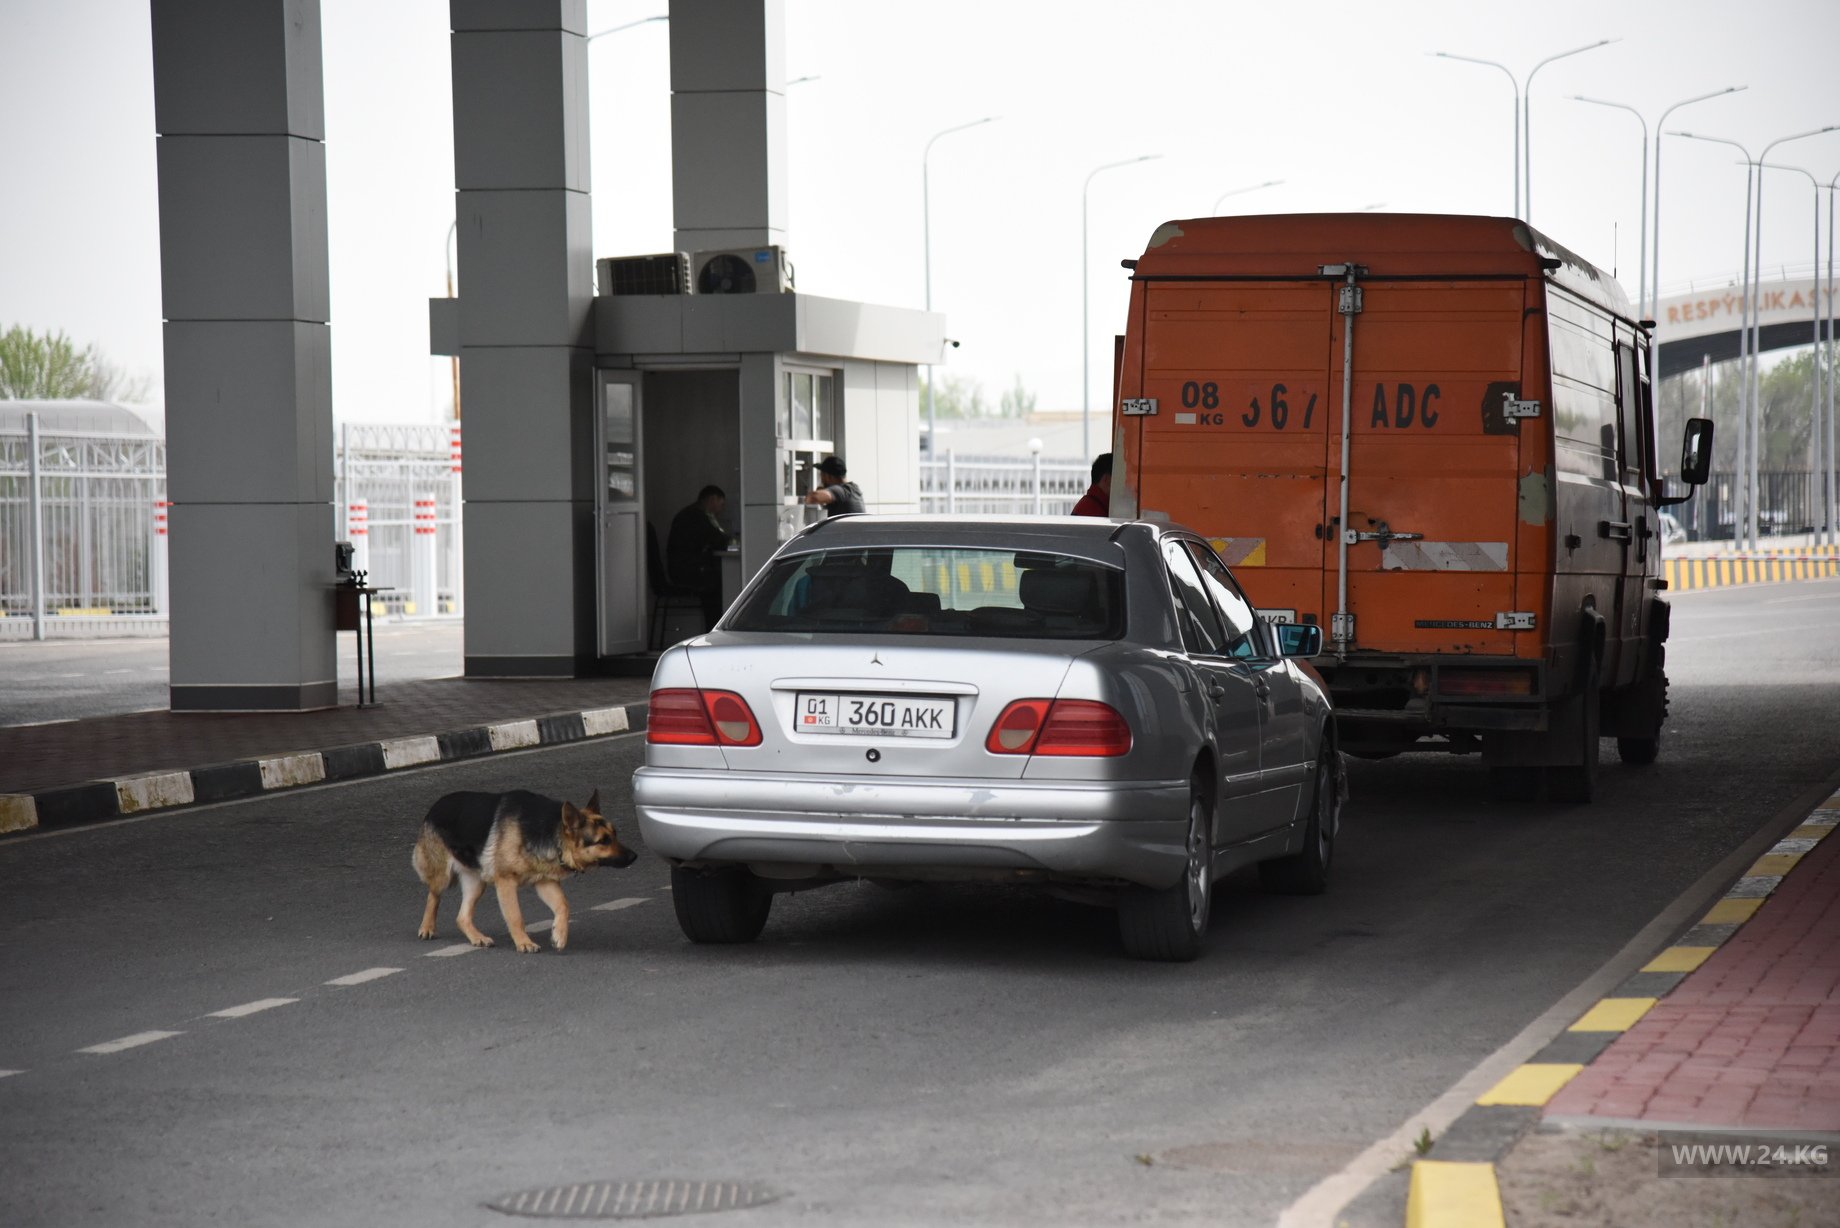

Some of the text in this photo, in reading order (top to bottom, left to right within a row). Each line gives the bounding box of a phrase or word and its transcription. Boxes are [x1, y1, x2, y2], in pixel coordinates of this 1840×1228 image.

[1182, 381, 1219, 409] 08
[1372, 383, 1440, 428] ADC
[1200, 413, 1224, 425] KG
[807, 698, 943, 729] 01 360 AKK
[818, 716, 831, 725] KG
